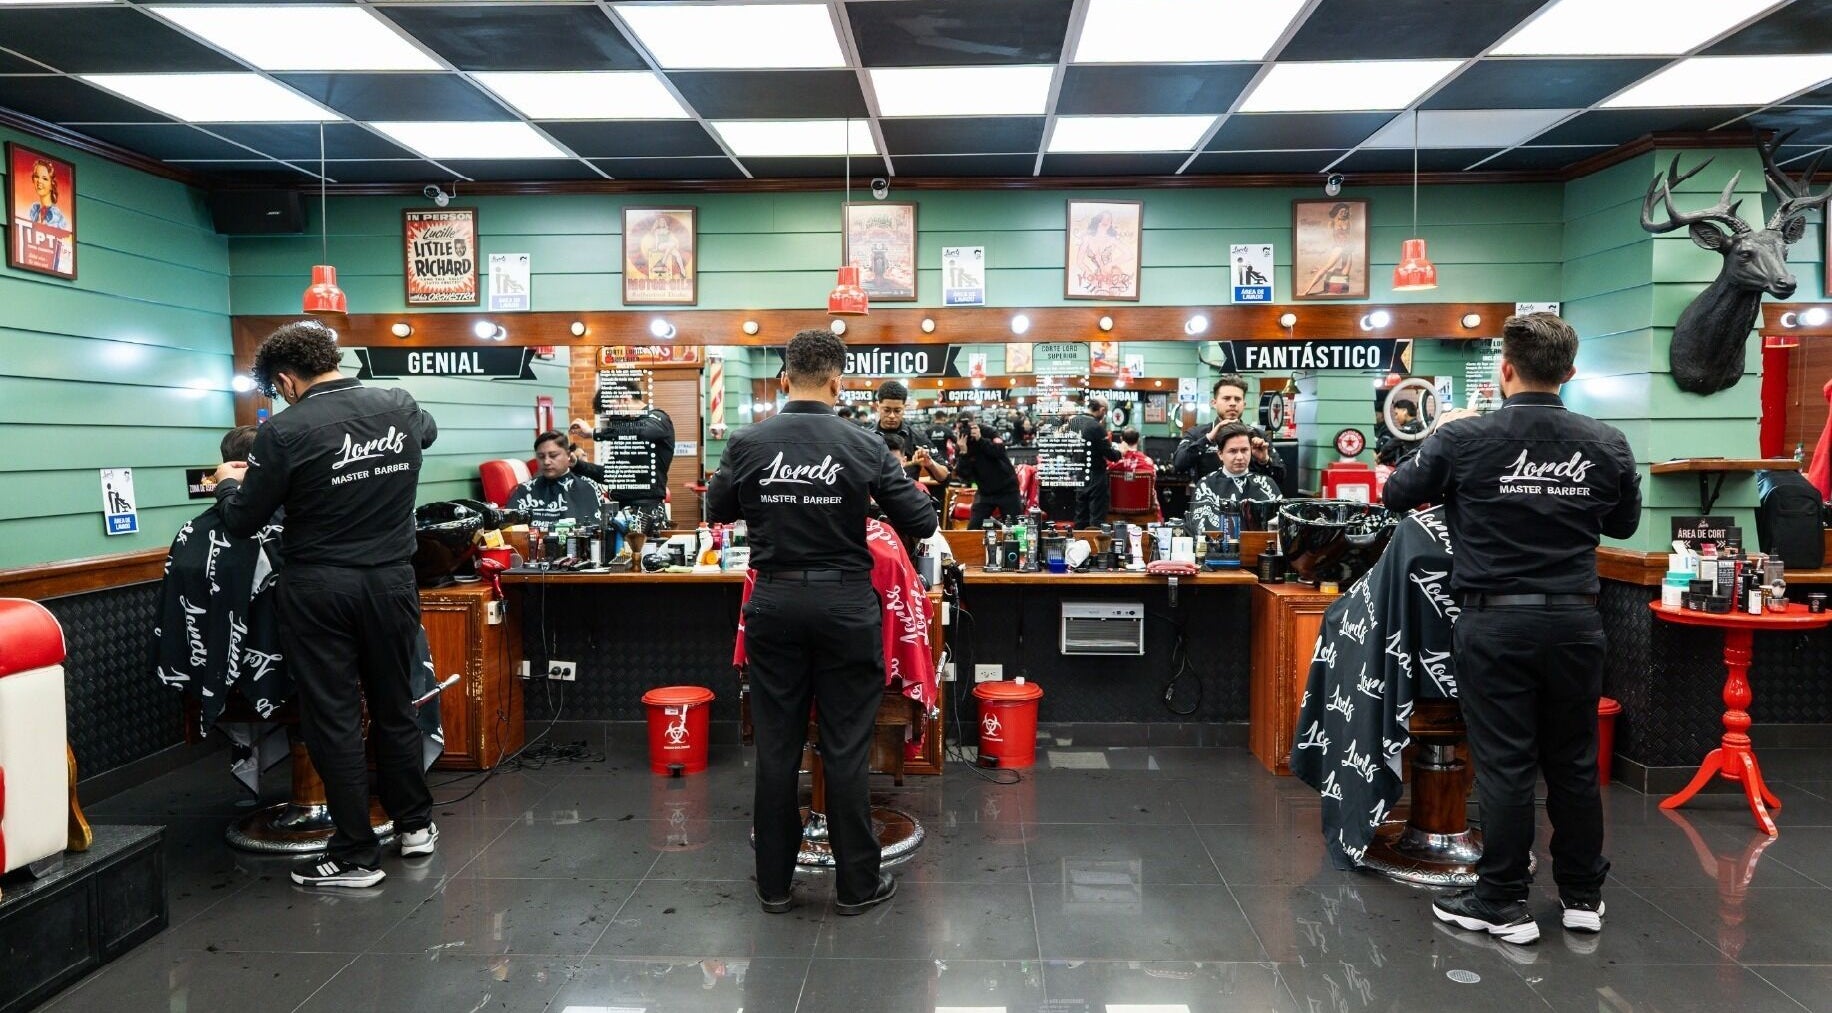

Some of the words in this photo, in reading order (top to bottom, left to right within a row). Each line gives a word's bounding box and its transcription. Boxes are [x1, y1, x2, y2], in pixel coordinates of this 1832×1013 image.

[423, 213, 472, 221] PERSON
[422, 226, 455, 240] Lucille
[414, 240, 453, 257] LITTLE
[415, 258, 472, 277] RICHARD
[408, 352, 485, 374] GENIAL
[843, 348, 928, 374] GNÍFICO
[1246, 342, 1380, 369] FANTÁSTICO
[332, 425, 408, 470] Lords
[331, 470, 369, 486] MASTER
[374, 462, 410, 476] BARBER
[759, 450, 845, 486] Lords
[1499, 448, 1596, 483] Lords
[760, 494, 797, 504] MASTER
[803, 496, 842, 504] BARBER
[1500, 485, 1541, 494] MASTER
[1547, 486, 1590, 496] BARBER
[1677, 528, 1696, 538] ÁREA
[1697, 529, 1706, 538] DE
[1707, 529, 1726, 538] CORT
[1339, 609, 1368, 645] Lords
